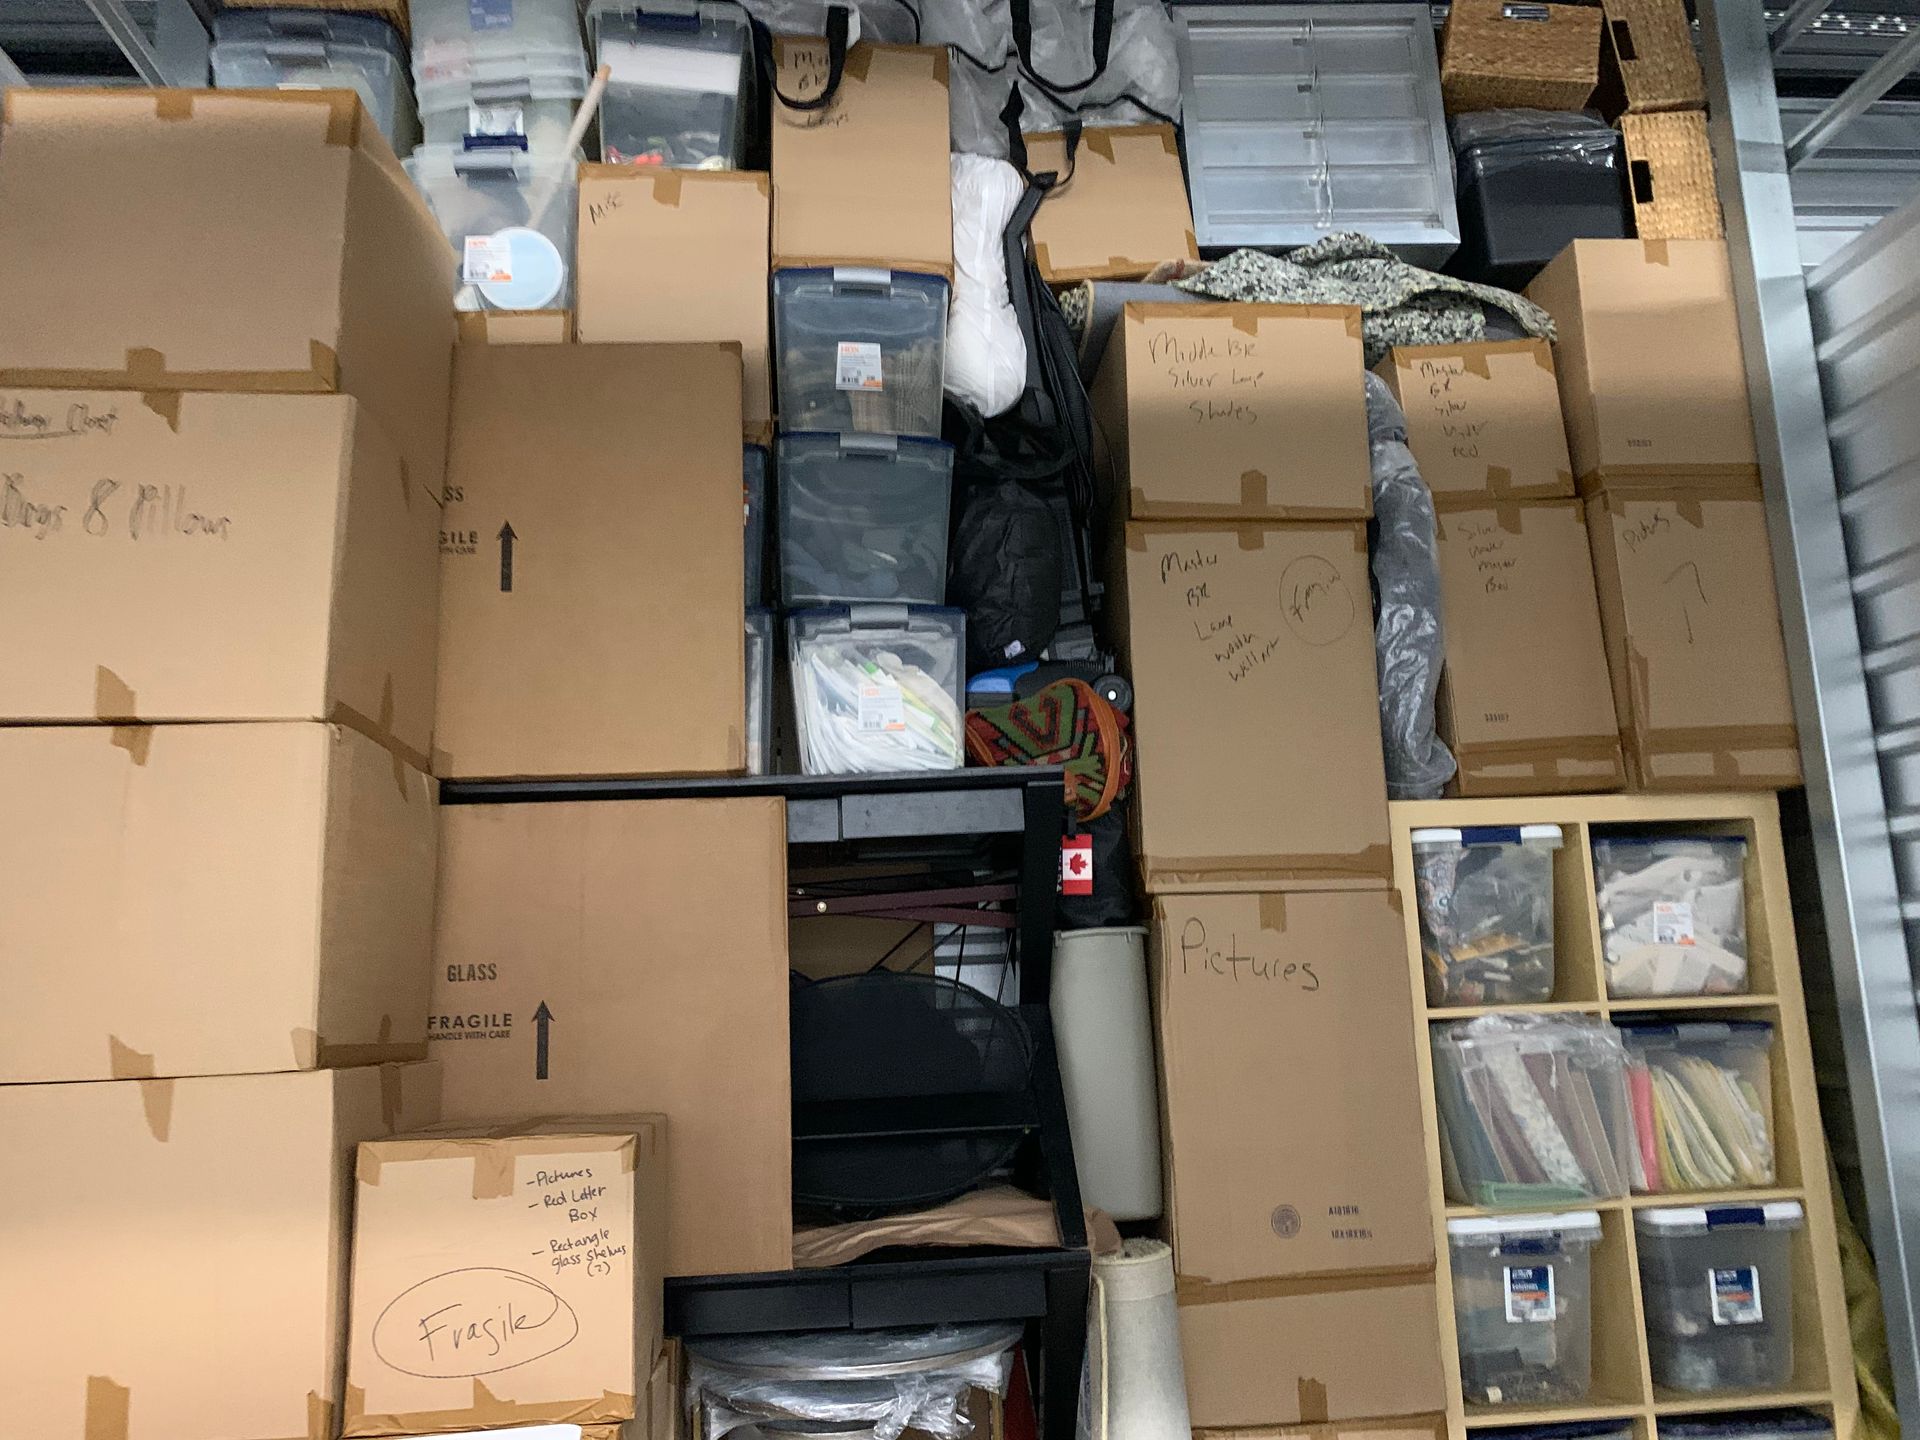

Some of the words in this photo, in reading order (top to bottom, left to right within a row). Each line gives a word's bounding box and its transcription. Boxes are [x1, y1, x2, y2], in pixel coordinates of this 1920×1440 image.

[1181, 917, 1319, 991] Pictures
[447, 963, 498, 982] GLASS
[427, 1013, 512, 1029] FRAGILE
[465, 1031, 487, 1040] WITH
[489, 1030, 511, 1039] CARE
[544, 1190, 567, 1208] Red
[419, 1302, 534, 1361] Fragile
